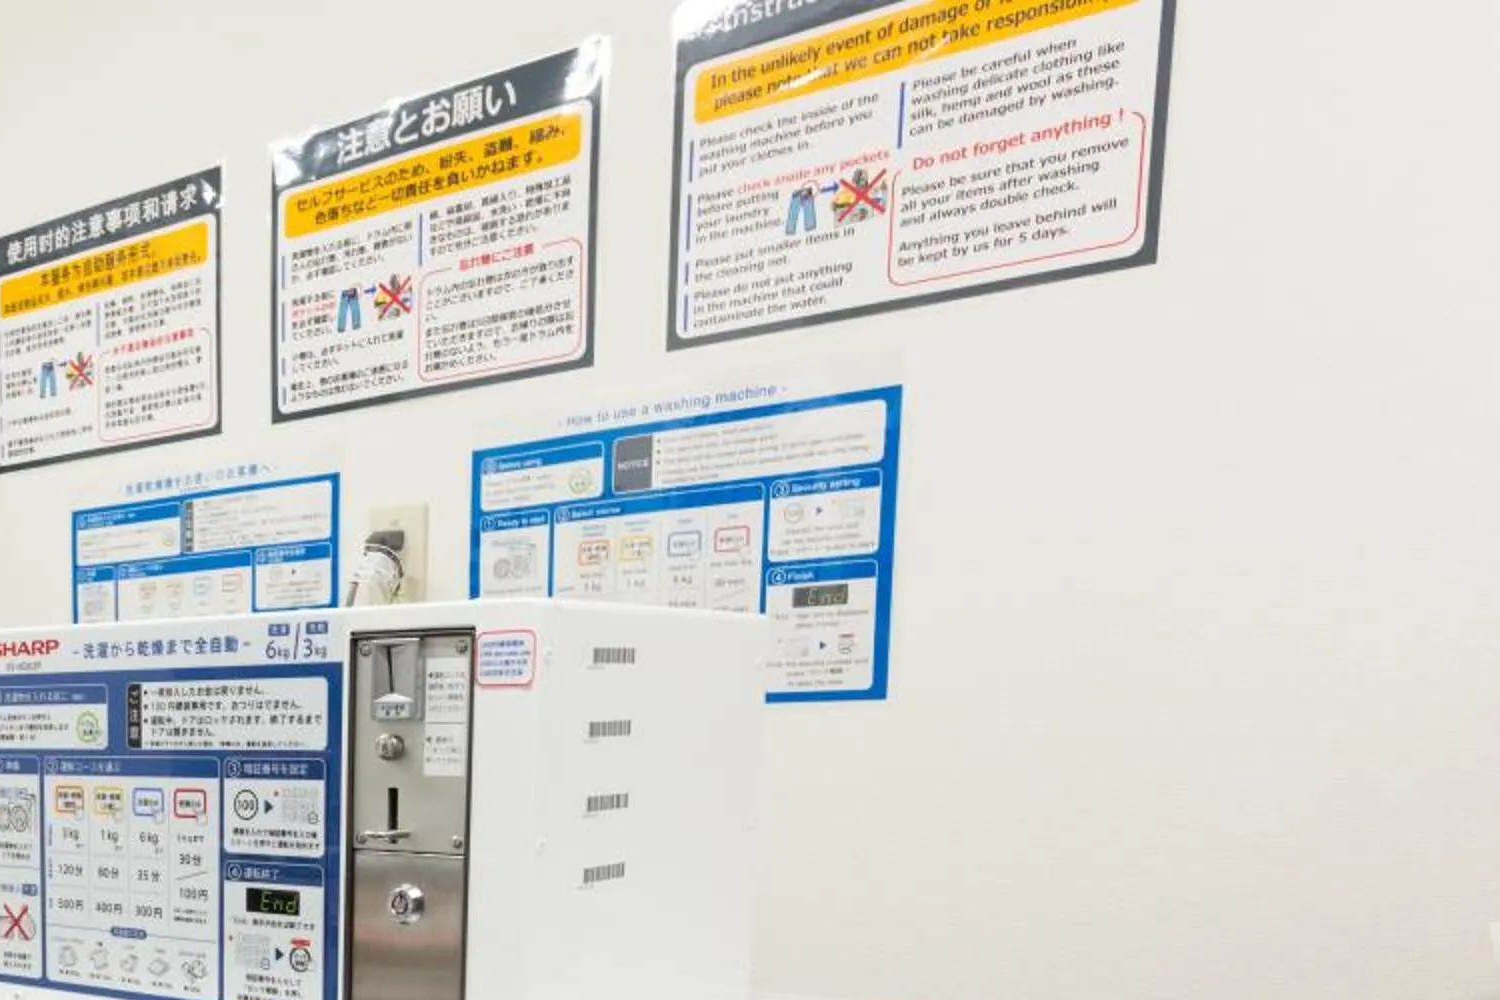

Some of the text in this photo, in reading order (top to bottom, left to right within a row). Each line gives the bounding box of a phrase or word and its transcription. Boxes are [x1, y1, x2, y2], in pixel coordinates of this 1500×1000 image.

[710, 1, 969, 89] In the unlikely event of damage
[912, 39, 1077, 90] Please be careful when
[713, 83, 761, 112] please
[843, 54, 869, 70] we
[873, 42, 901, 65] can
[907, 34, 936, 55] not
[911, 40, 1126, 106] washing delicate clothing like
[941, 95, 981, 113] hemp
[985, 86, 1013, 102] and
[1017, 74, 1052, 93] wool
[1056, 71, 1073, 83] as
[1077, 58, 1121, 78] these
[336, 79, 519, 164] 注意とお願い
[739, 121, 773, 138] check
[909, 123, 933, 137] can
[937, 116, 954, 129] be
[959, 99, 1024, 125] damaged
[1029, 93, 1047, 110] by
[912, 111, 1113, 171] Do not forget anything
[900, 160, 1100, 212] all your items after washing
[901, 137, 1129, 196] Please be sure that you remove
[7, 183, 198, 265] 使用时的注意事项和请求
[899, 198, 1117, 252] Anything you leave behind will
[900, 214, 925, 227] and
[929, 202, 976, 222] always
[980, 191, 1029, 211] double
[898, 232, 1028, 267] be kept by us for 5
[653, 393, 712, 414] washing
[715, 385, 777, 403] machine
[83, 635, 239, 659] 洗濯から乾燥まで全自動
[259, 891, 298, 913] End
